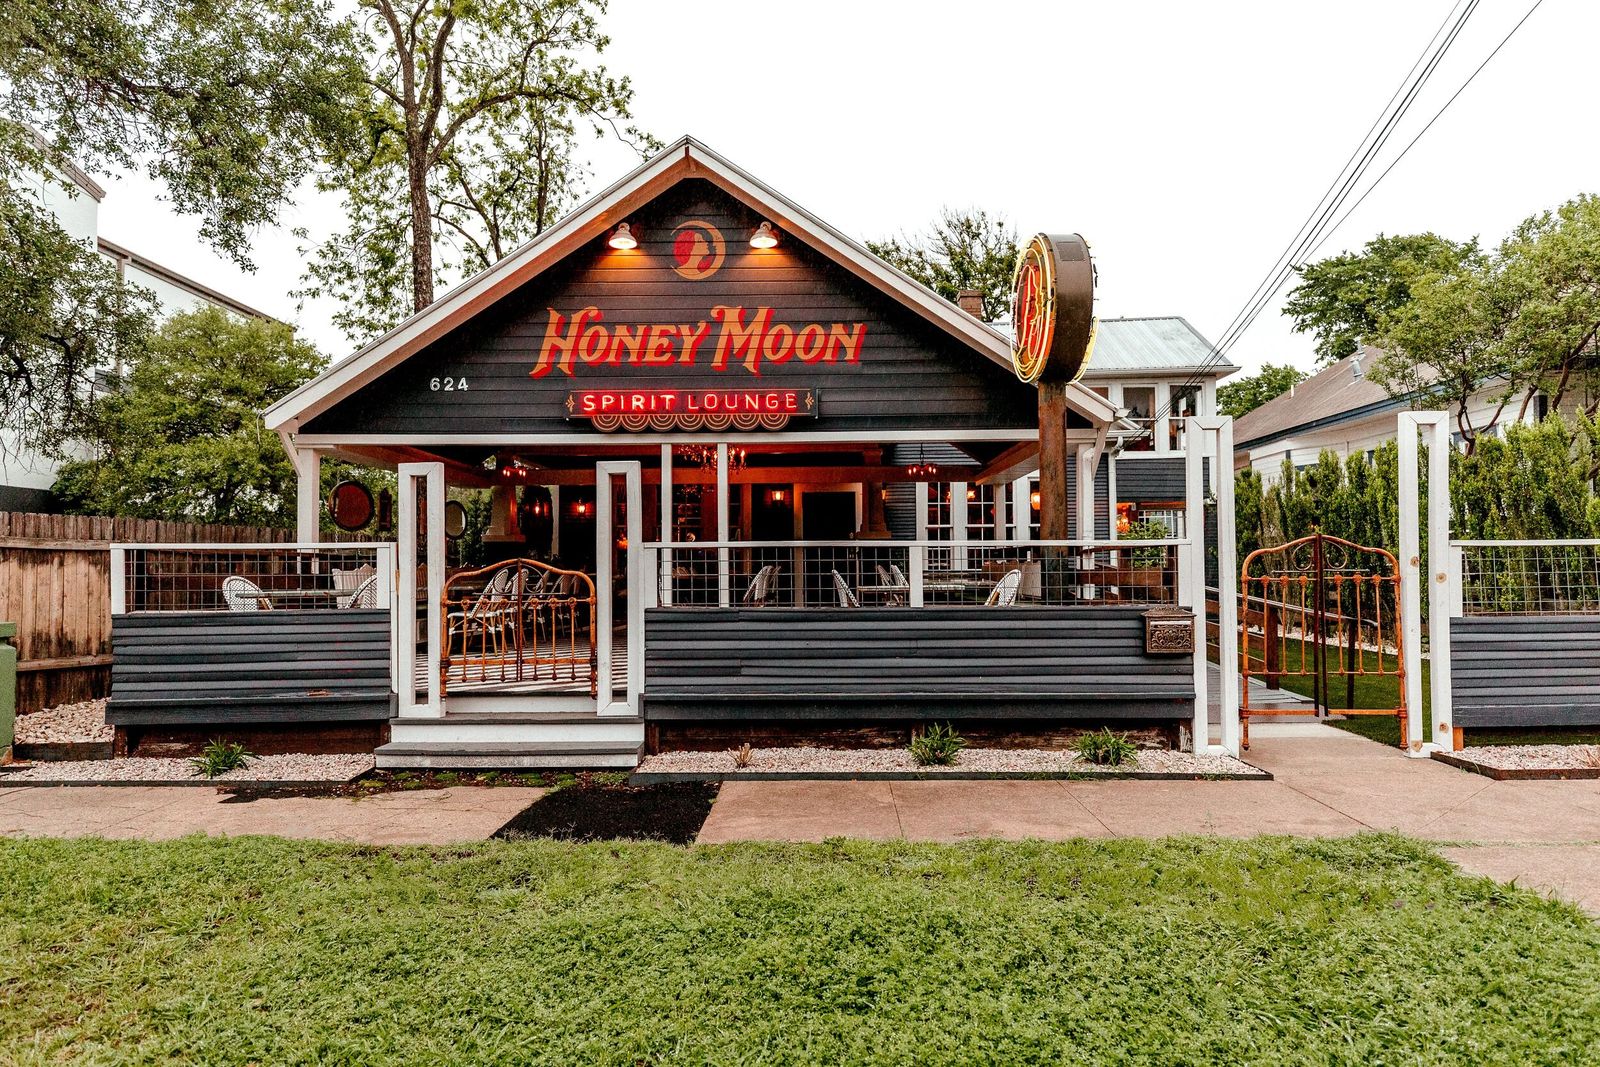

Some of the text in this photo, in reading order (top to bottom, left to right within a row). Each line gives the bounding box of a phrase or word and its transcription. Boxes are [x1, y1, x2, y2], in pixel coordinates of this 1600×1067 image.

[530, 305, 867, 378] HONEY MOON
[429, 376, 469, 392] 624
[582, 392, 798, 412] SPIRIT LOUNGE
